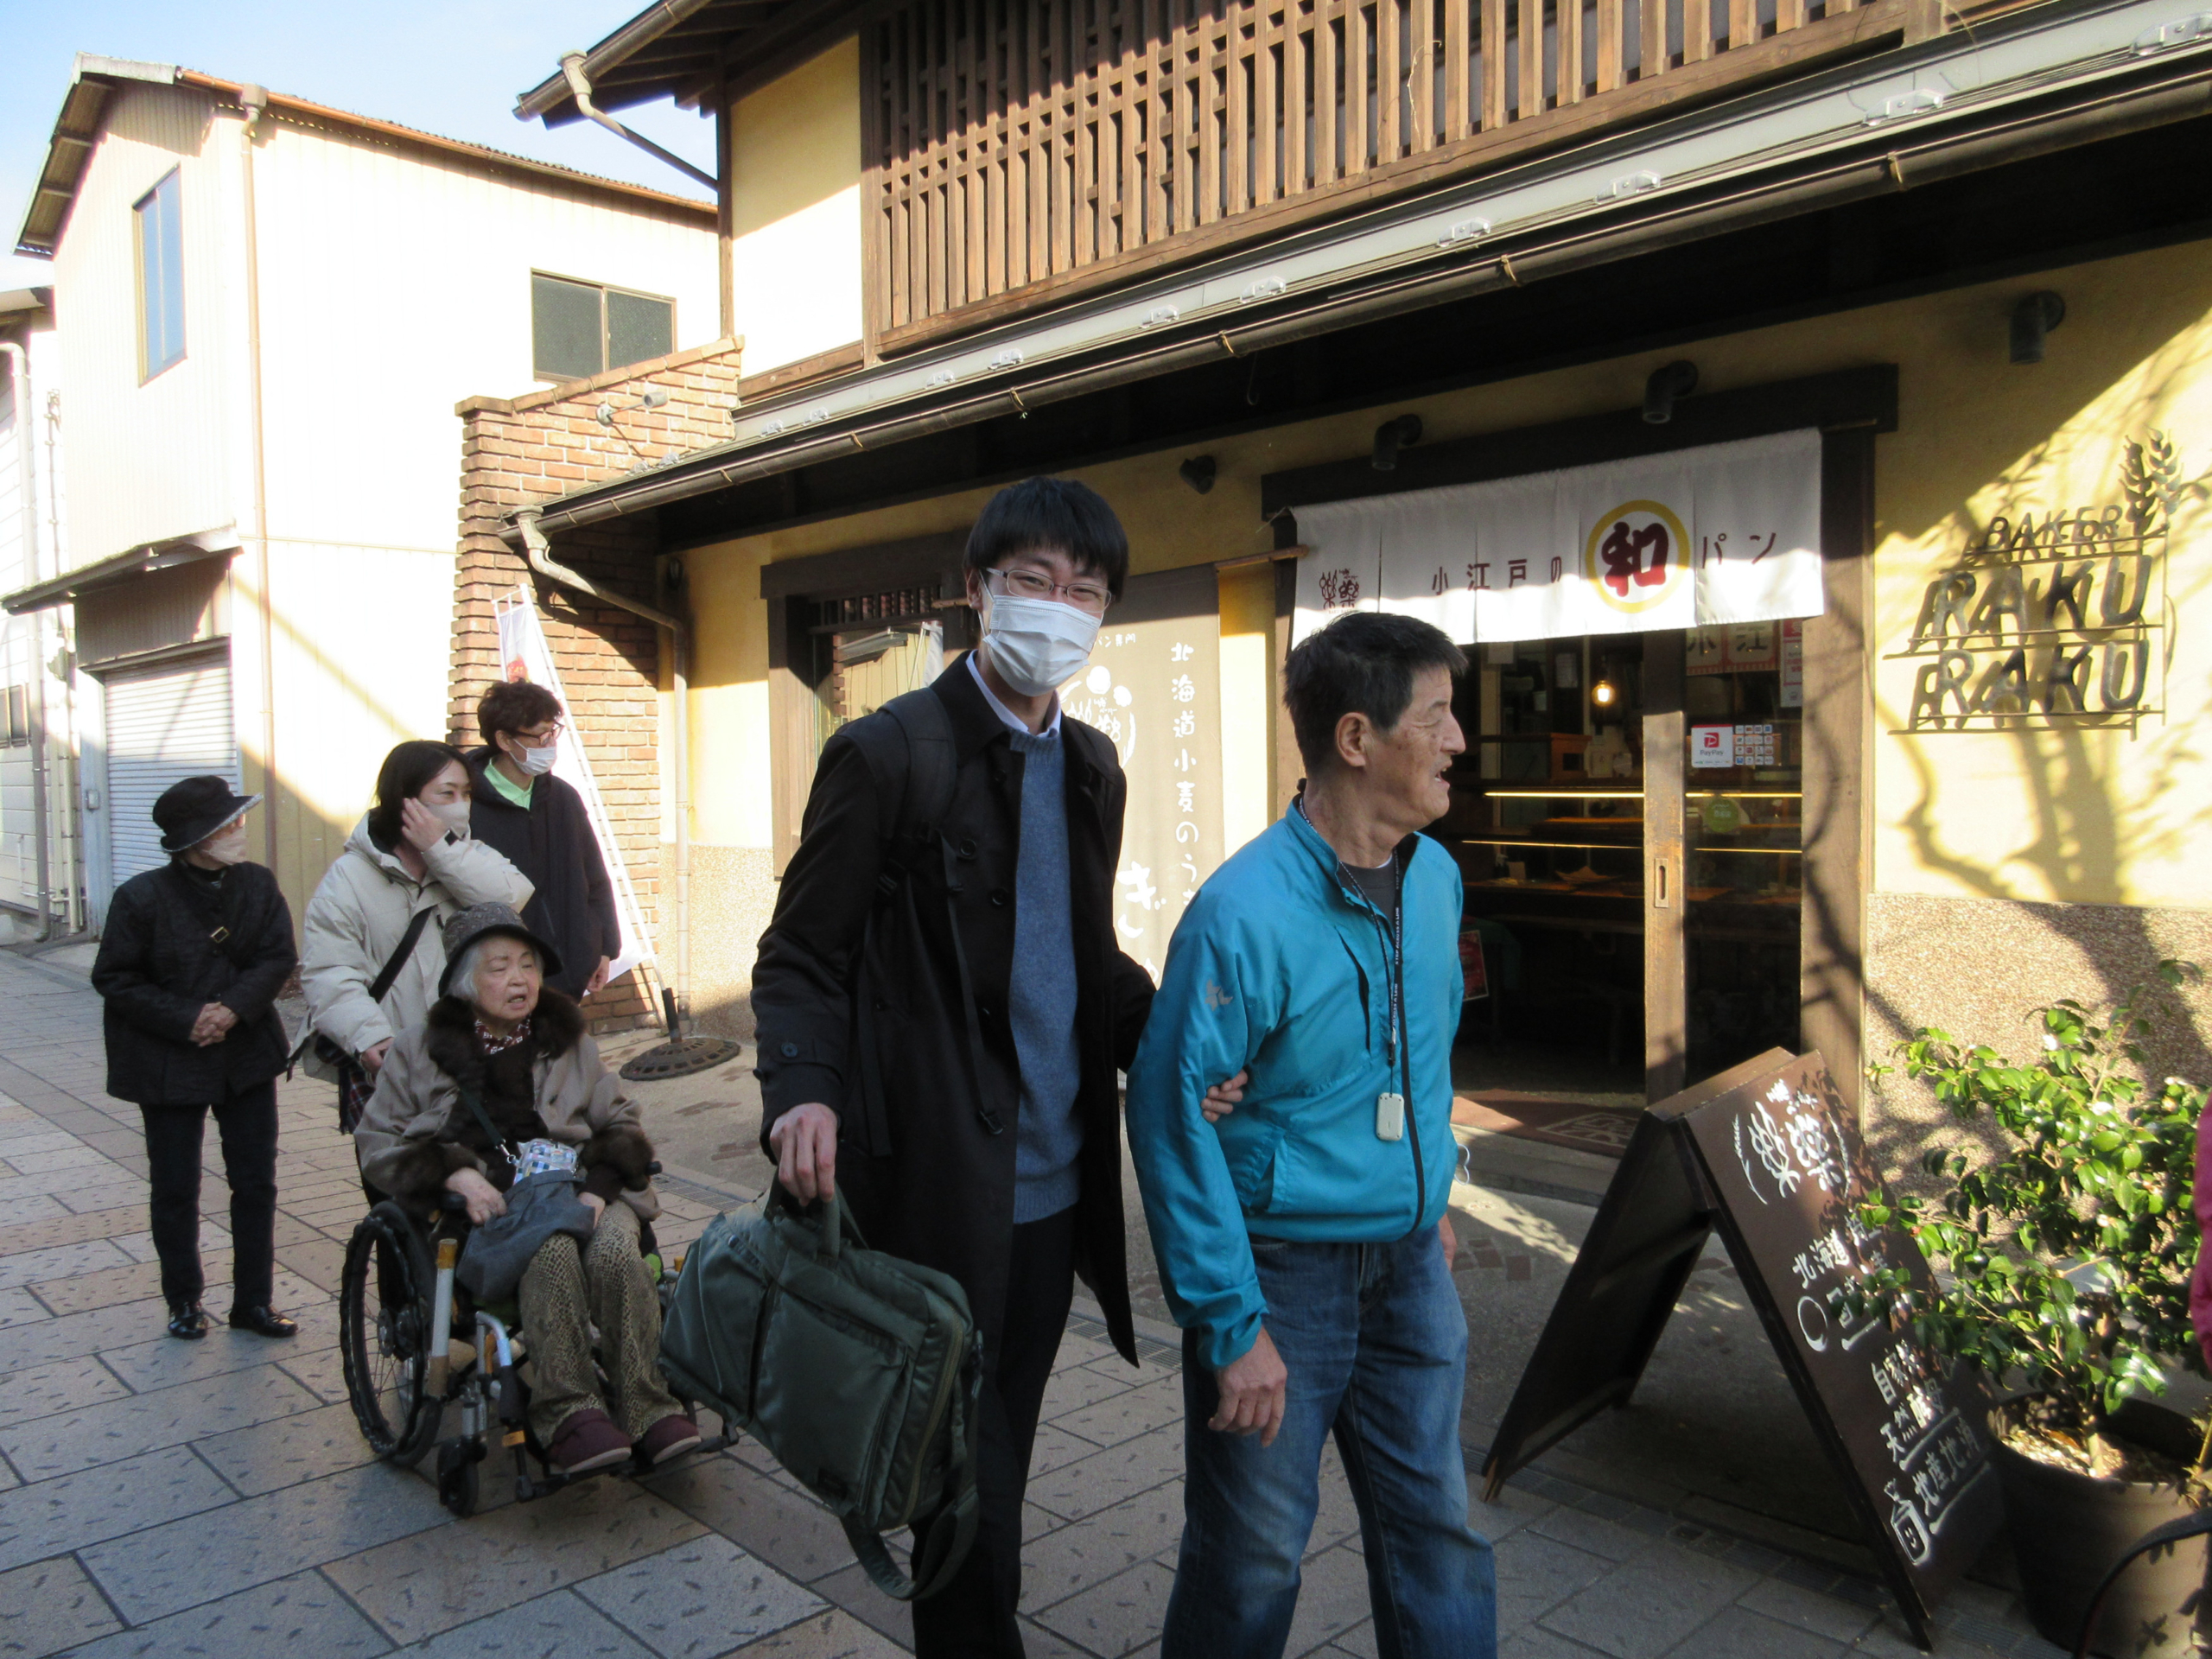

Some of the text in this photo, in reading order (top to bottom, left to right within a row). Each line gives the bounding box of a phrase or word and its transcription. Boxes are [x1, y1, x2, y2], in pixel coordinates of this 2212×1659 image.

[1931, 554, 2152, 637] RAKU
[1936, 639, 2150, 715] RAKU
[1912, 1416, 1981, 1516] 地産地消
